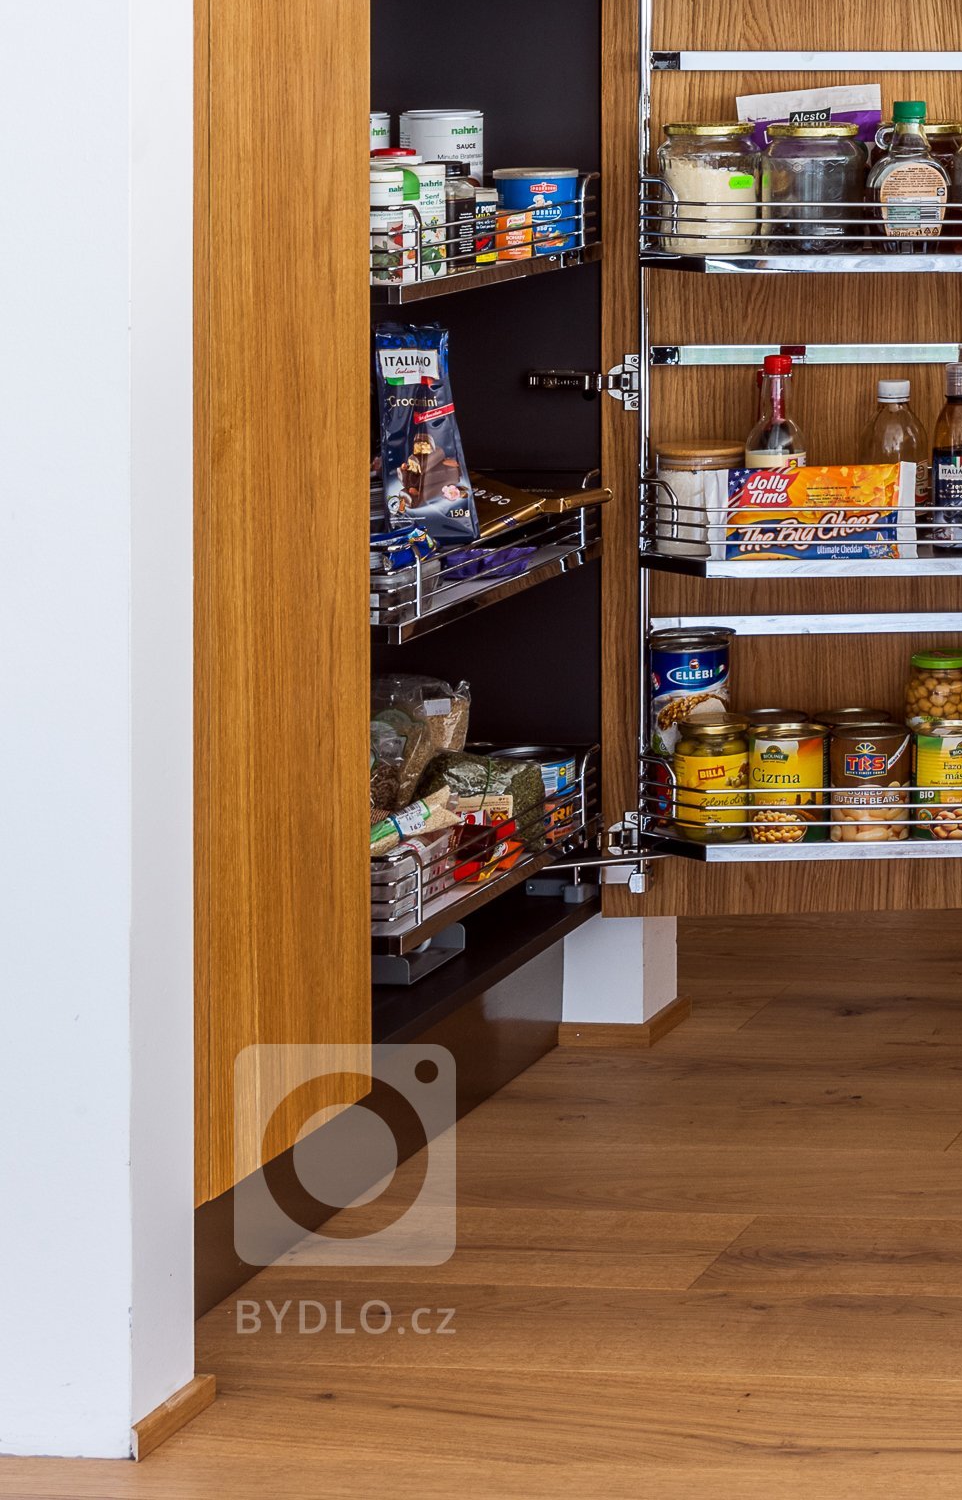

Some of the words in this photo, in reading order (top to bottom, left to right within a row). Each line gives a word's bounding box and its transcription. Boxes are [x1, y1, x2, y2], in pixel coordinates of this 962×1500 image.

[791, 112, 827, 122] Alesto
[451, 125, 479, 135] nahrin
[747, 475, 789, 491] Jolly
[749, 491, 787, 503] Time
[450, 509, 464, 518] 150
[738, 527, 774, 552] The
[778, 518, 817, 550] Big
[817, 546, 839, 554] Ultimate
[841, 545, 863, 554] Cheddar
[675, 669, 713, 680] ELLEBI
[846, 756, 885, 771] TRS
[699, 768, 723, 779] BILLA
[752, 767, 800, 784] Cizrna
[835, 796, 867, 804] BUTTER
[870, 794, 899, 805] BEANS
[919, 791, 934, 799] BIO
[700, 796, 729, 807] Zelené
